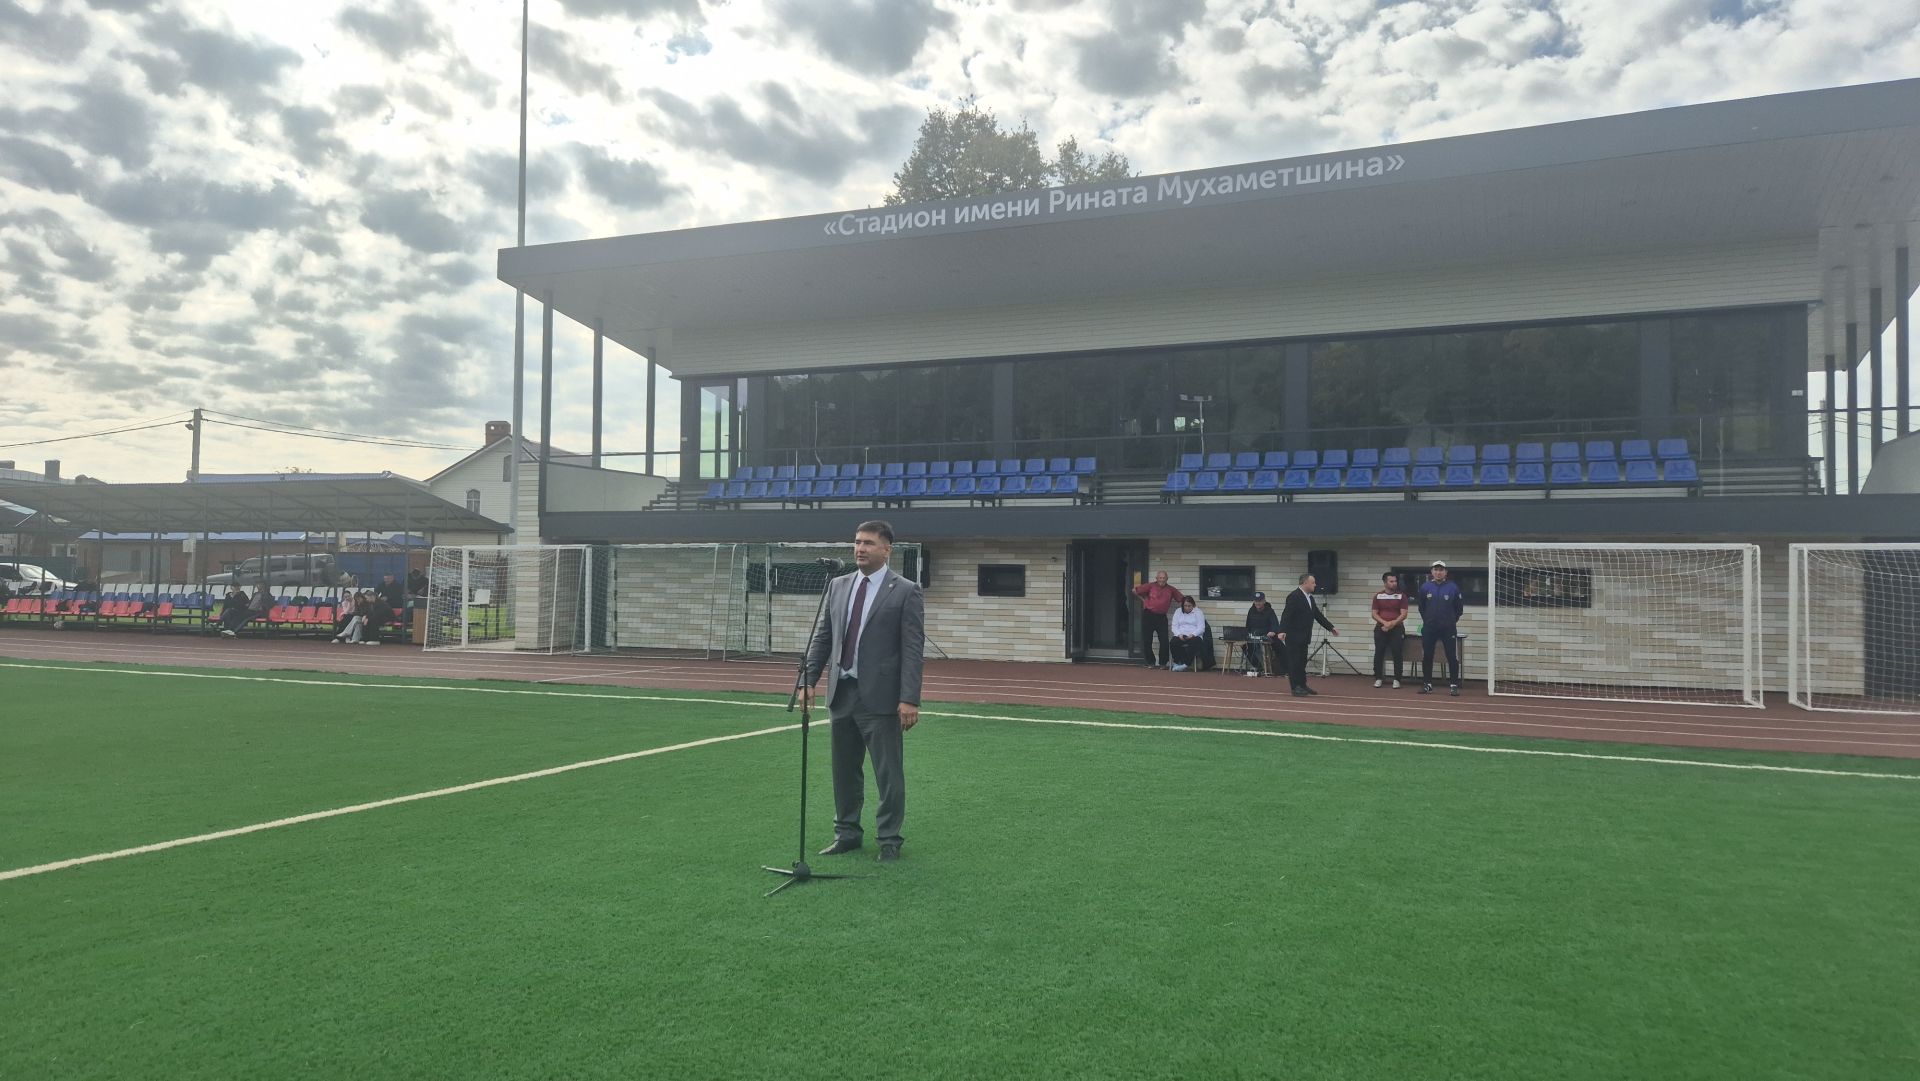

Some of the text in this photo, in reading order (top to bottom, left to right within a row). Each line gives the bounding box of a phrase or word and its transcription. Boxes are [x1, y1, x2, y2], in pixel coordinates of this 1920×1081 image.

[824, 154, 1406, 236] «Стадион имени Рината Мухаметшина»
